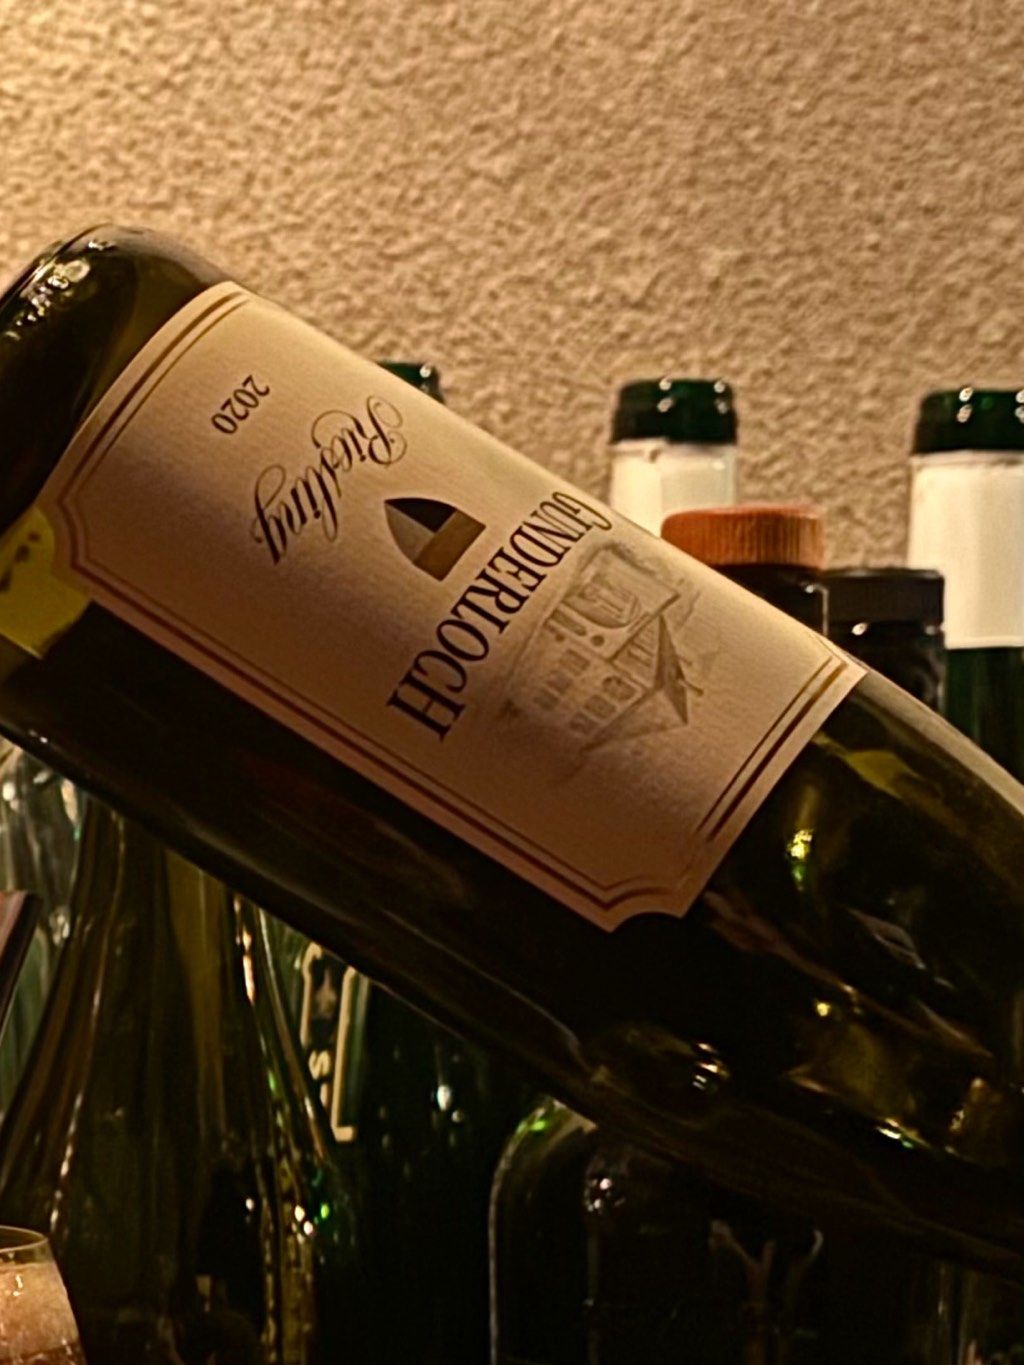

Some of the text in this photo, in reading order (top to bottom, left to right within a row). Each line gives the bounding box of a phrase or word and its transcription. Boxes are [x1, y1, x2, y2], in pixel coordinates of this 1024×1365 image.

[212, 373, 270, 435] 2020
[250, 396, 408, 564] Riesling
[386, 490, 613, 741] GUNDERLOCH
